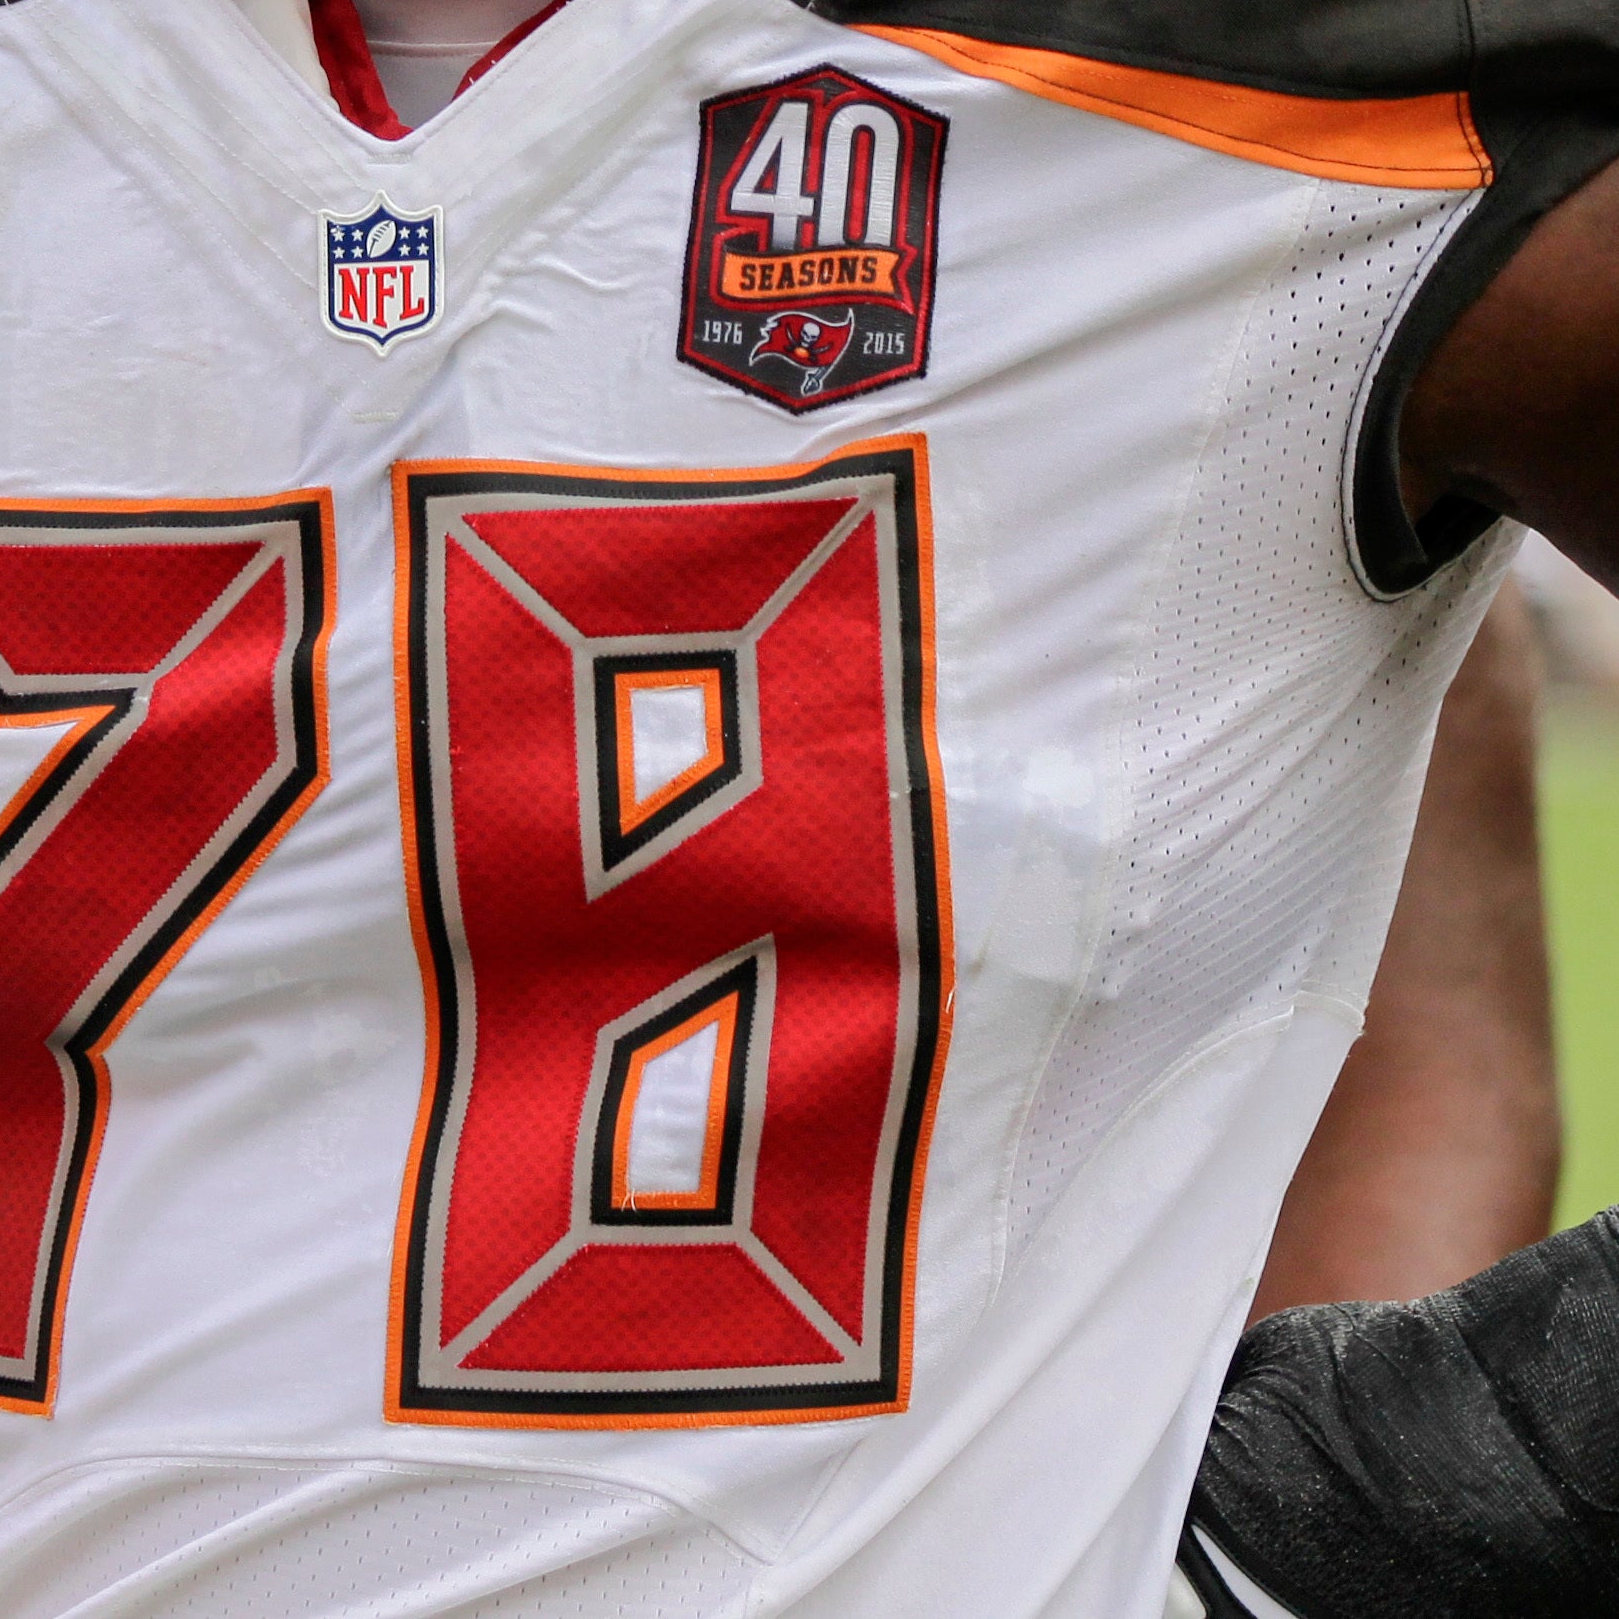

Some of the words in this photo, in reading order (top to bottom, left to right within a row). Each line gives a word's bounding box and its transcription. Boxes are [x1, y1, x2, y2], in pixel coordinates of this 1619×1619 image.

[730, 100, 900, 250] 40
[739, 256, 878, 292] SEASONS
[338, 265, 425, 329] NFL
[702, 319, 743, 345] 1976
[862, 331, 905, 356] 2015
